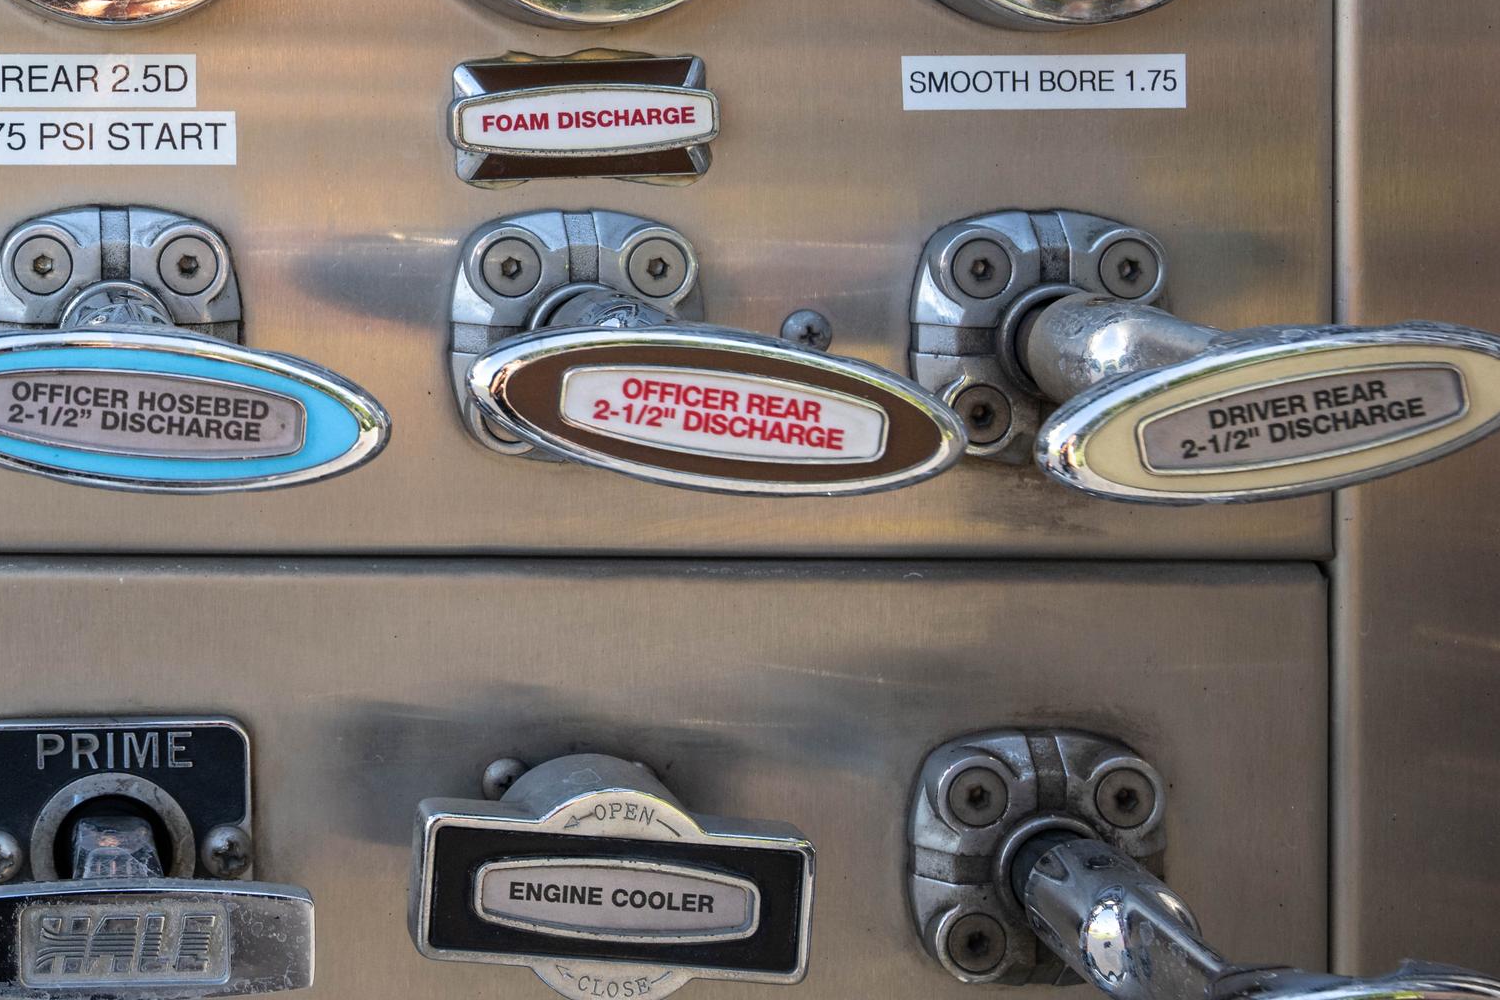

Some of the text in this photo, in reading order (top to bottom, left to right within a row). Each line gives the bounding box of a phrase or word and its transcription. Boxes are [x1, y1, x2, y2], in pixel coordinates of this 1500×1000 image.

[1, 64, 188, 93] REAR 2.5D
[909, 69, 1177, 94] SMOOTH BORE 1.75
[482, 106, 696, 132] FOAM DISCHARGE
[39, 122, 93, 151] PSI
[107, 122, 227, 151] START
[12, 381, 269, 422] OFFICER HOSEBED
[622, 378, 822, 423] OFFICER REAR
[1208, 379, 1388, 430] DRIVER REAR
[101, 410, 262, 443] DISCHARGE
[683, 410, 845, 451] DISCHARGE
[1268, 397, 1427, 445] DISCHARGE
[37, 731, 193, 770] PRIME
[595, 803, 656, 826] OPEN
[509, 881, 715, 914] ENGINE COOLER
[577, 974, 653, 998] CLOSE
